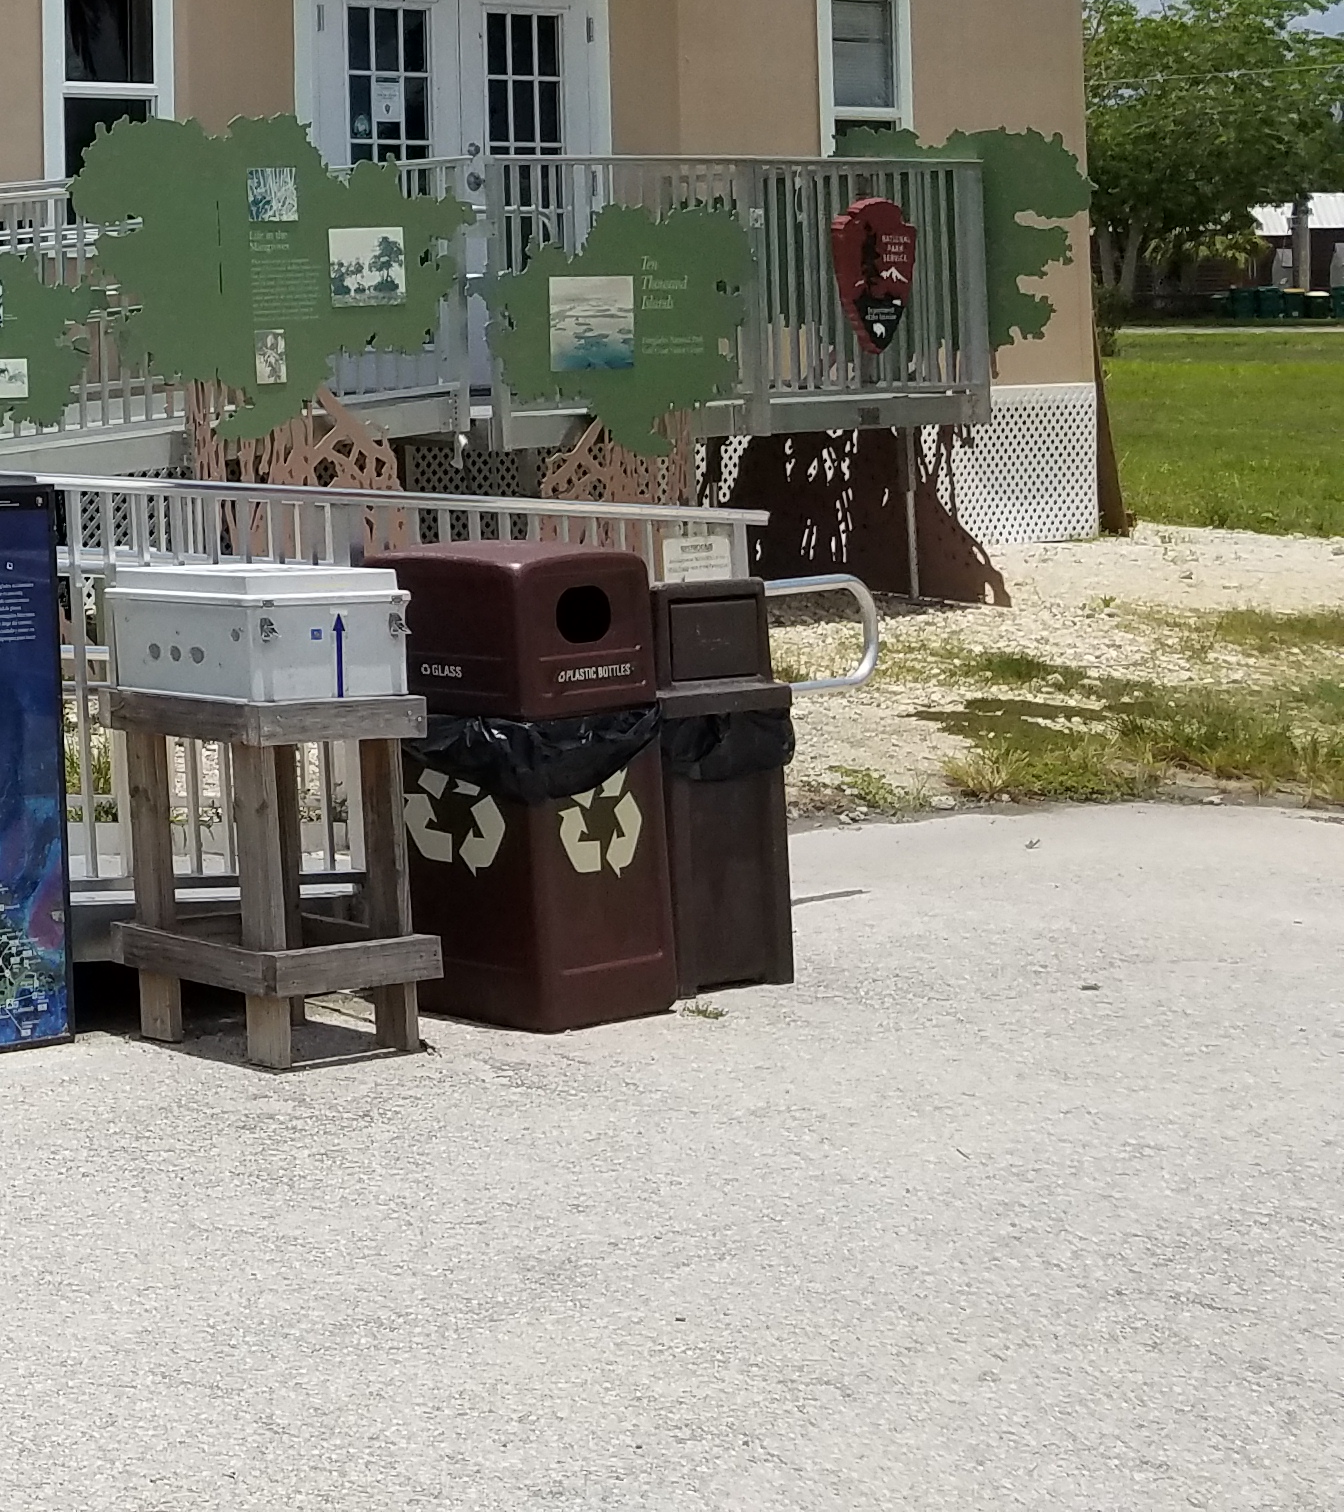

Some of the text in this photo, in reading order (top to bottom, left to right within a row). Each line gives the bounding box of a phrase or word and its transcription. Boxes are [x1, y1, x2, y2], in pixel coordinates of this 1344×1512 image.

[881, 234, 910, 243] NATIONAL
[641, 255, 658, 270] Ten
[883, 254, 907, 262] SERVICE
[641, 274, 688, 290] Thousand
[641, 294, 673, 309] Islands
[432, 664, 462, 678] GLASS
[565, 663, 631, 681] PLASTIC BOTTLES
